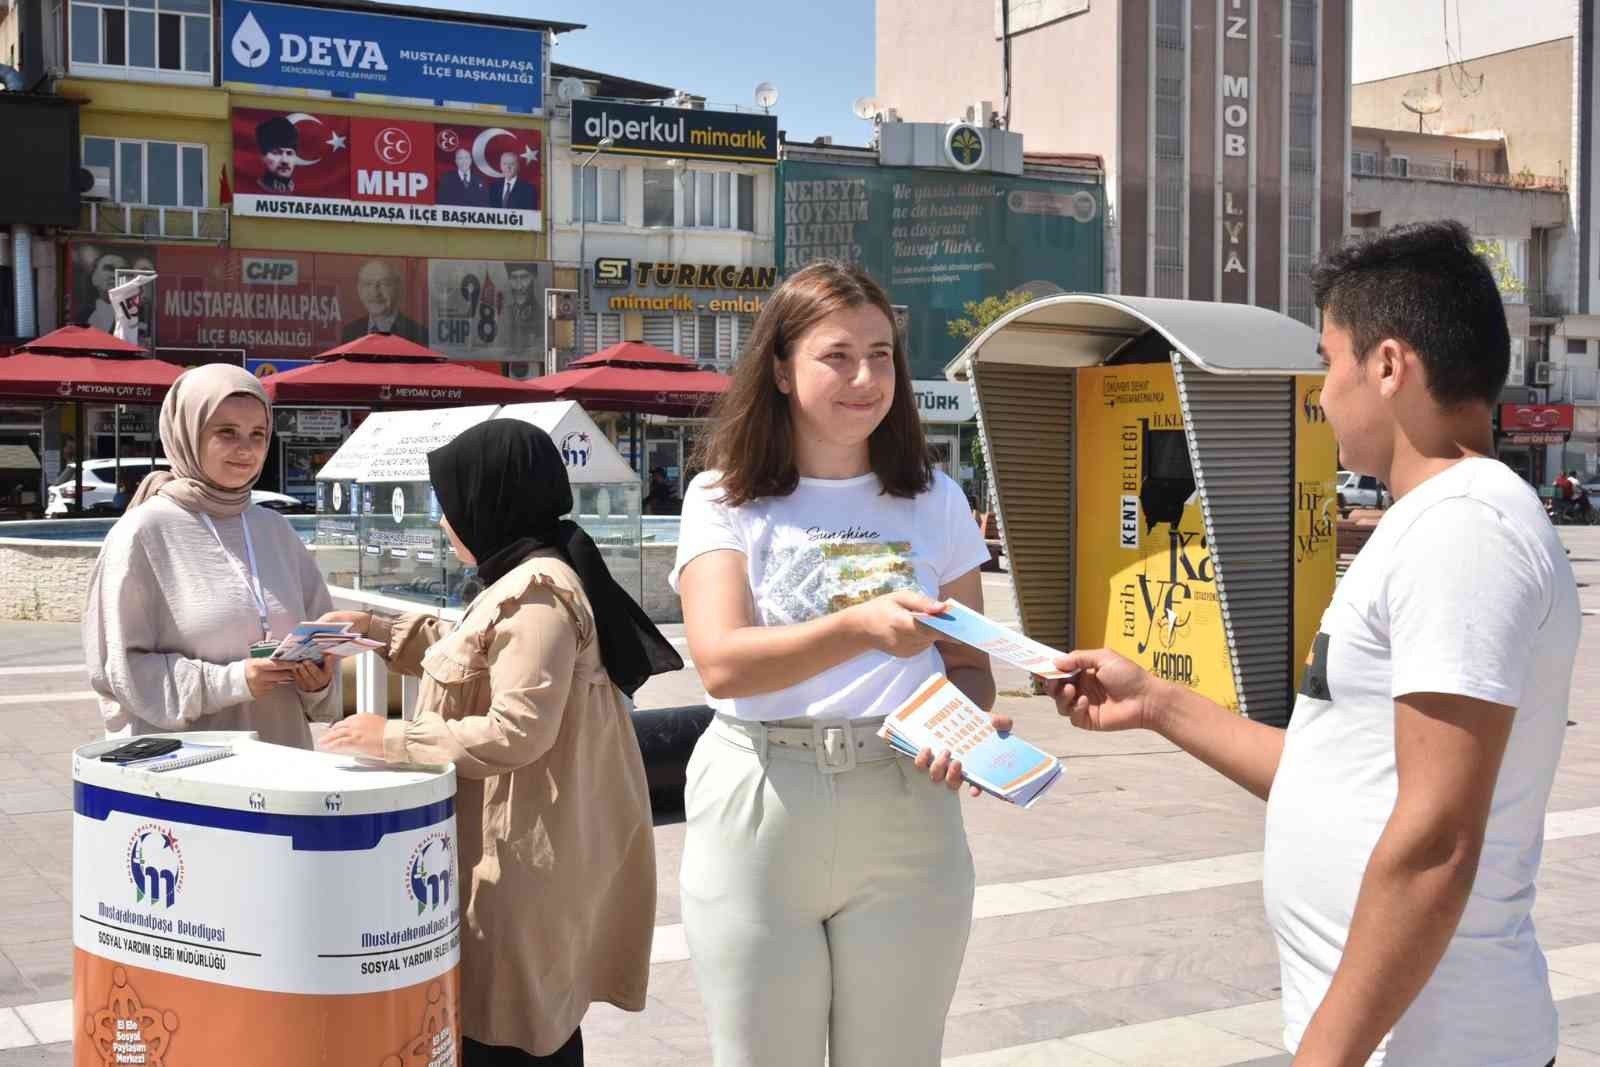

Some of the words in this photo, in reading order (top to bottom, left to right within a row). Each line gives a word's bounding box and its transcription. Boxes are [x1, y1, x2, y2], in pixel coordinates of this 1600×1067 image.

[279, 33, 389, 71] DEVA
[400, 50, 535, 72] MUSTAFAKEMALPAŞA
[422, 63, 452, 78] İLÇE
[455, 67, 535, 85] BAŞKANLIĞI
[585, 111, 685, 143] alperkul
[690, 126, 767, 149] mimarlık
[357, 169, 428, 198] MHP
[255, 198, 406, 222] MUSTAFAKEMALPAŞA
[409, 204, 438, 222] İLÇE
[442, 207, 524, 227] BAŞKANLIĞI
[245, 262, 293, 281] CHP
[598, 260, 629, 279] ST
[636, 261, 777, 289] TÜRKCAN
[165, 290, 342, 327] MUSTAFAKEMALPAŞA
[608, 293, 694, 312] mimarlık
[197, 324, 226, 347] İLÇE
[229, 327, 312, 350] BAŞKANLIĞI
[438, 319, 470, 345] CHP
[76, 384, 115, 395] MEYDAN
[117, 385, 135, 396] ÇAY
[395, 387, 429, 398] MEYDAN
[914, 391, 960, 410] TÜRK
[806, 525, 881, 542] Sunshine
[1122, 499, 1137, 545] KENT
[1120, 583, 1136, 639] tarih
[98, 901, 173, 934] Mustafakemalpaşa
[177, 920, 226, 943] Belediyesi
[98, 930, 122, 949] SOSYAL
[123, 936, 151, 956] YARDIM
[152, 944, 175, 961] İŞLERİ
[176, 945, 226, 971] MÜDÜRLÜĞÜ
[360, 958, 401, 975] SOSYAL
[402, 949, 433, 969] YARDIM
